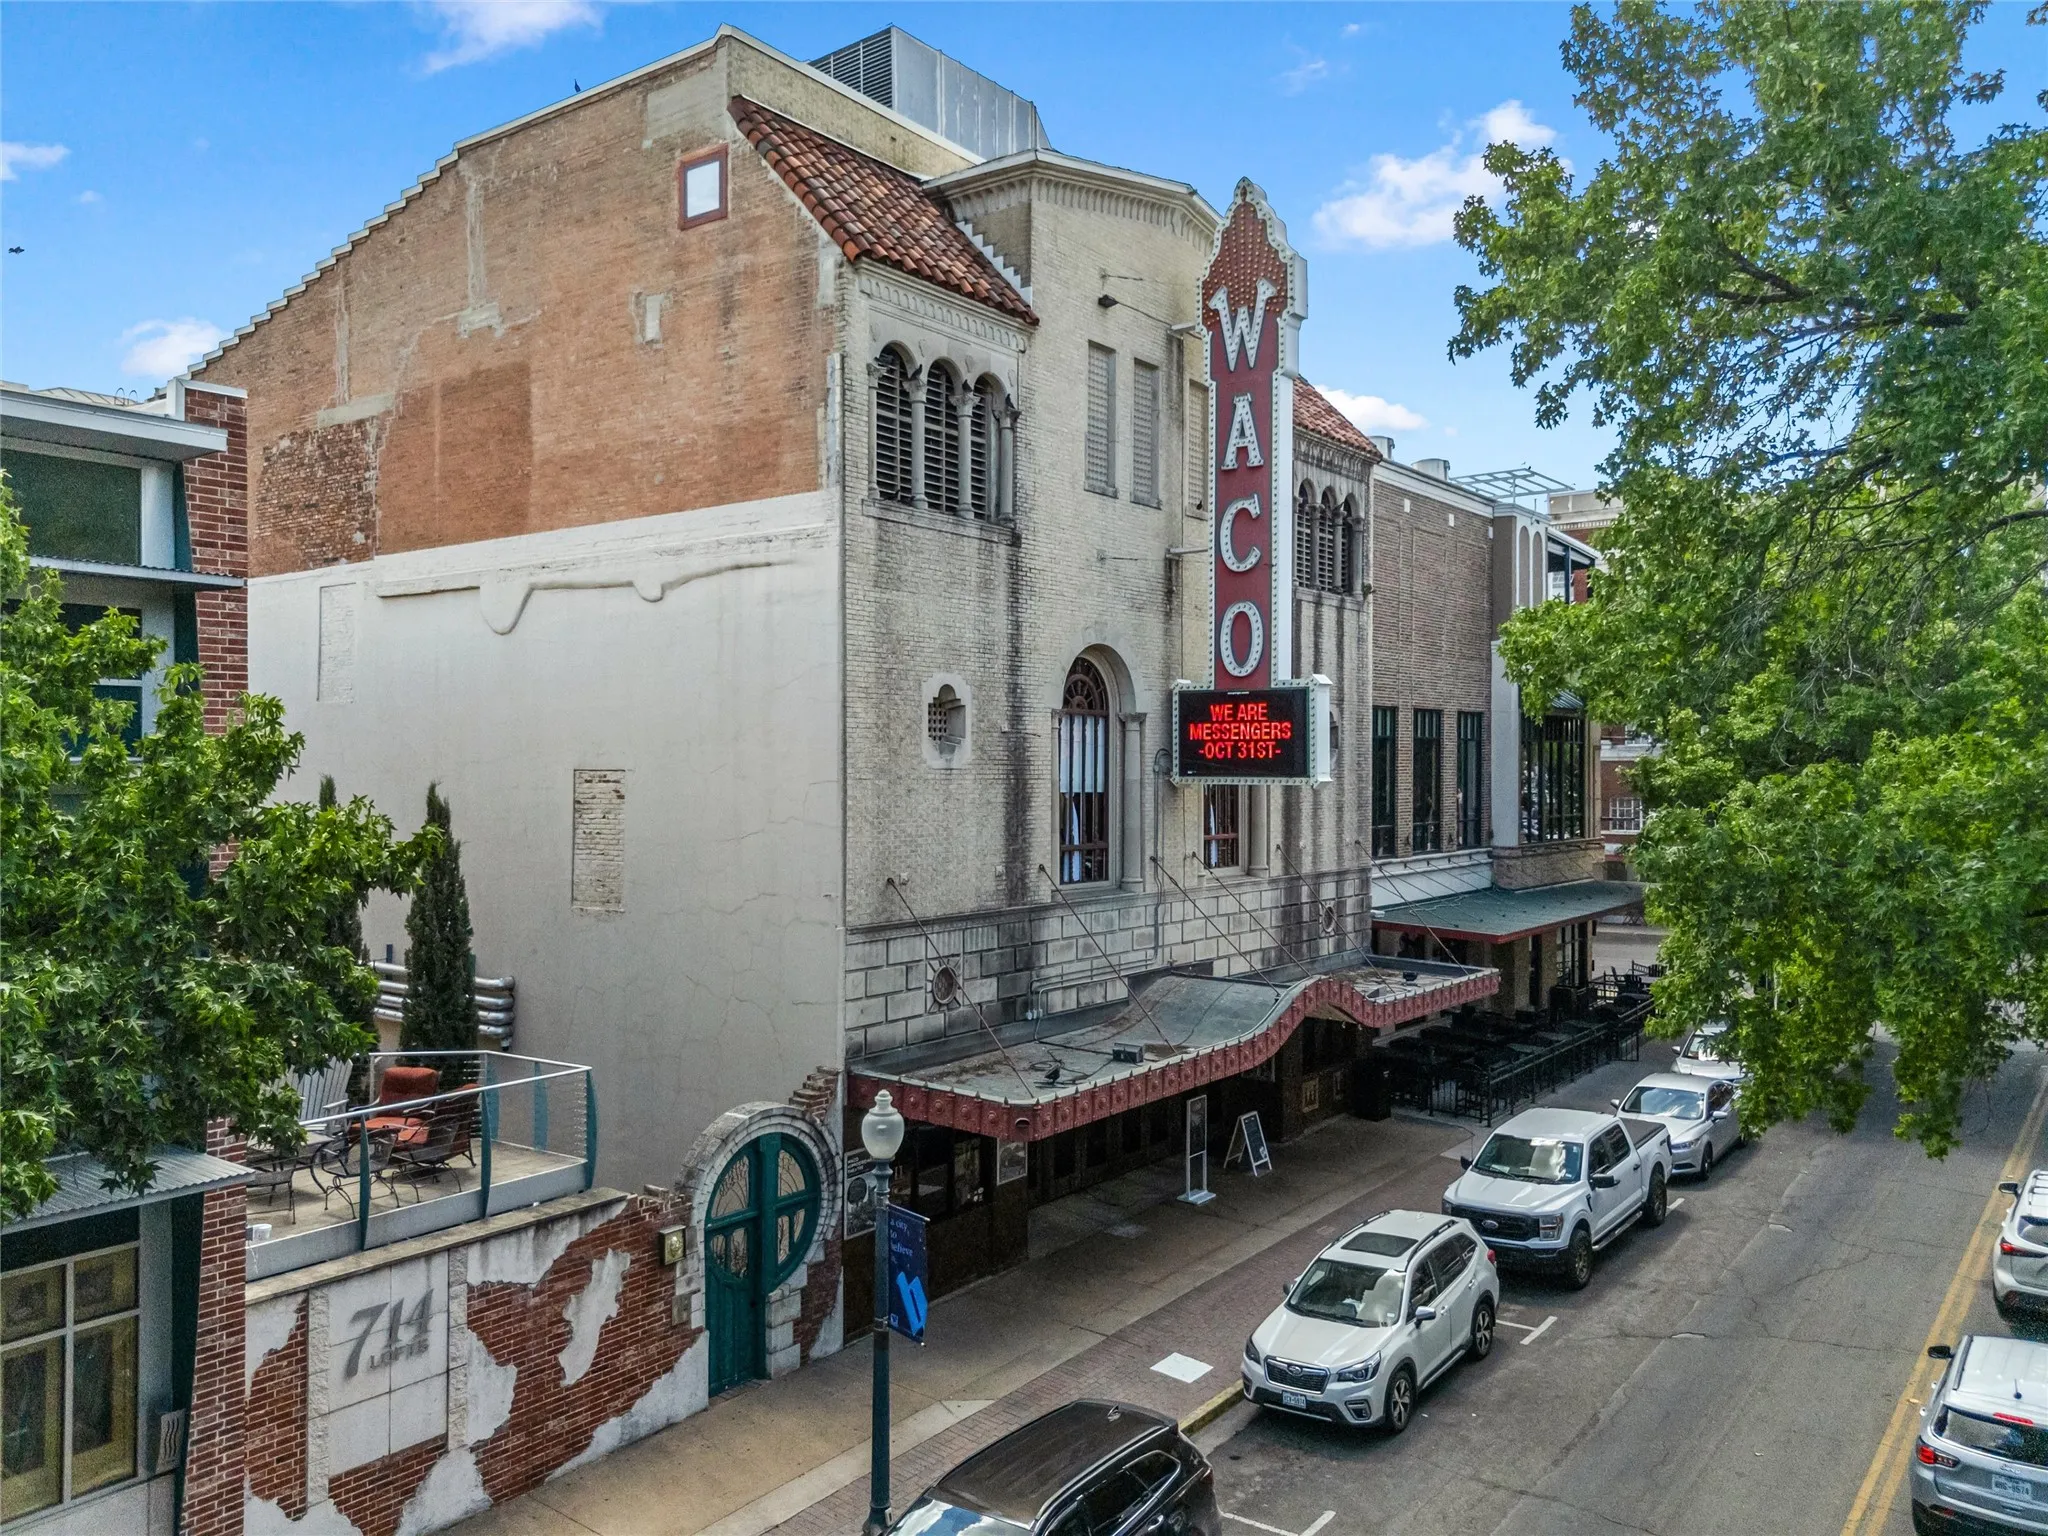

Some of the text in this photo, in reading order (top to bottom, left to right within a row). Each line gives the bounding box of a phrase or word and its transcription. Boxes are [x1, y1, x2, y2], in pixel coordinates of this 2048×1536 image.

[1208, 277, 1277, 677] WACO
[1210, 703, 1268, 721] WE ARE
[1189, 722, 1292, 740] MESSENGERS
[1199, 742, 1234, 759] -OCT
[343, 1287, 434, 1380] 714
